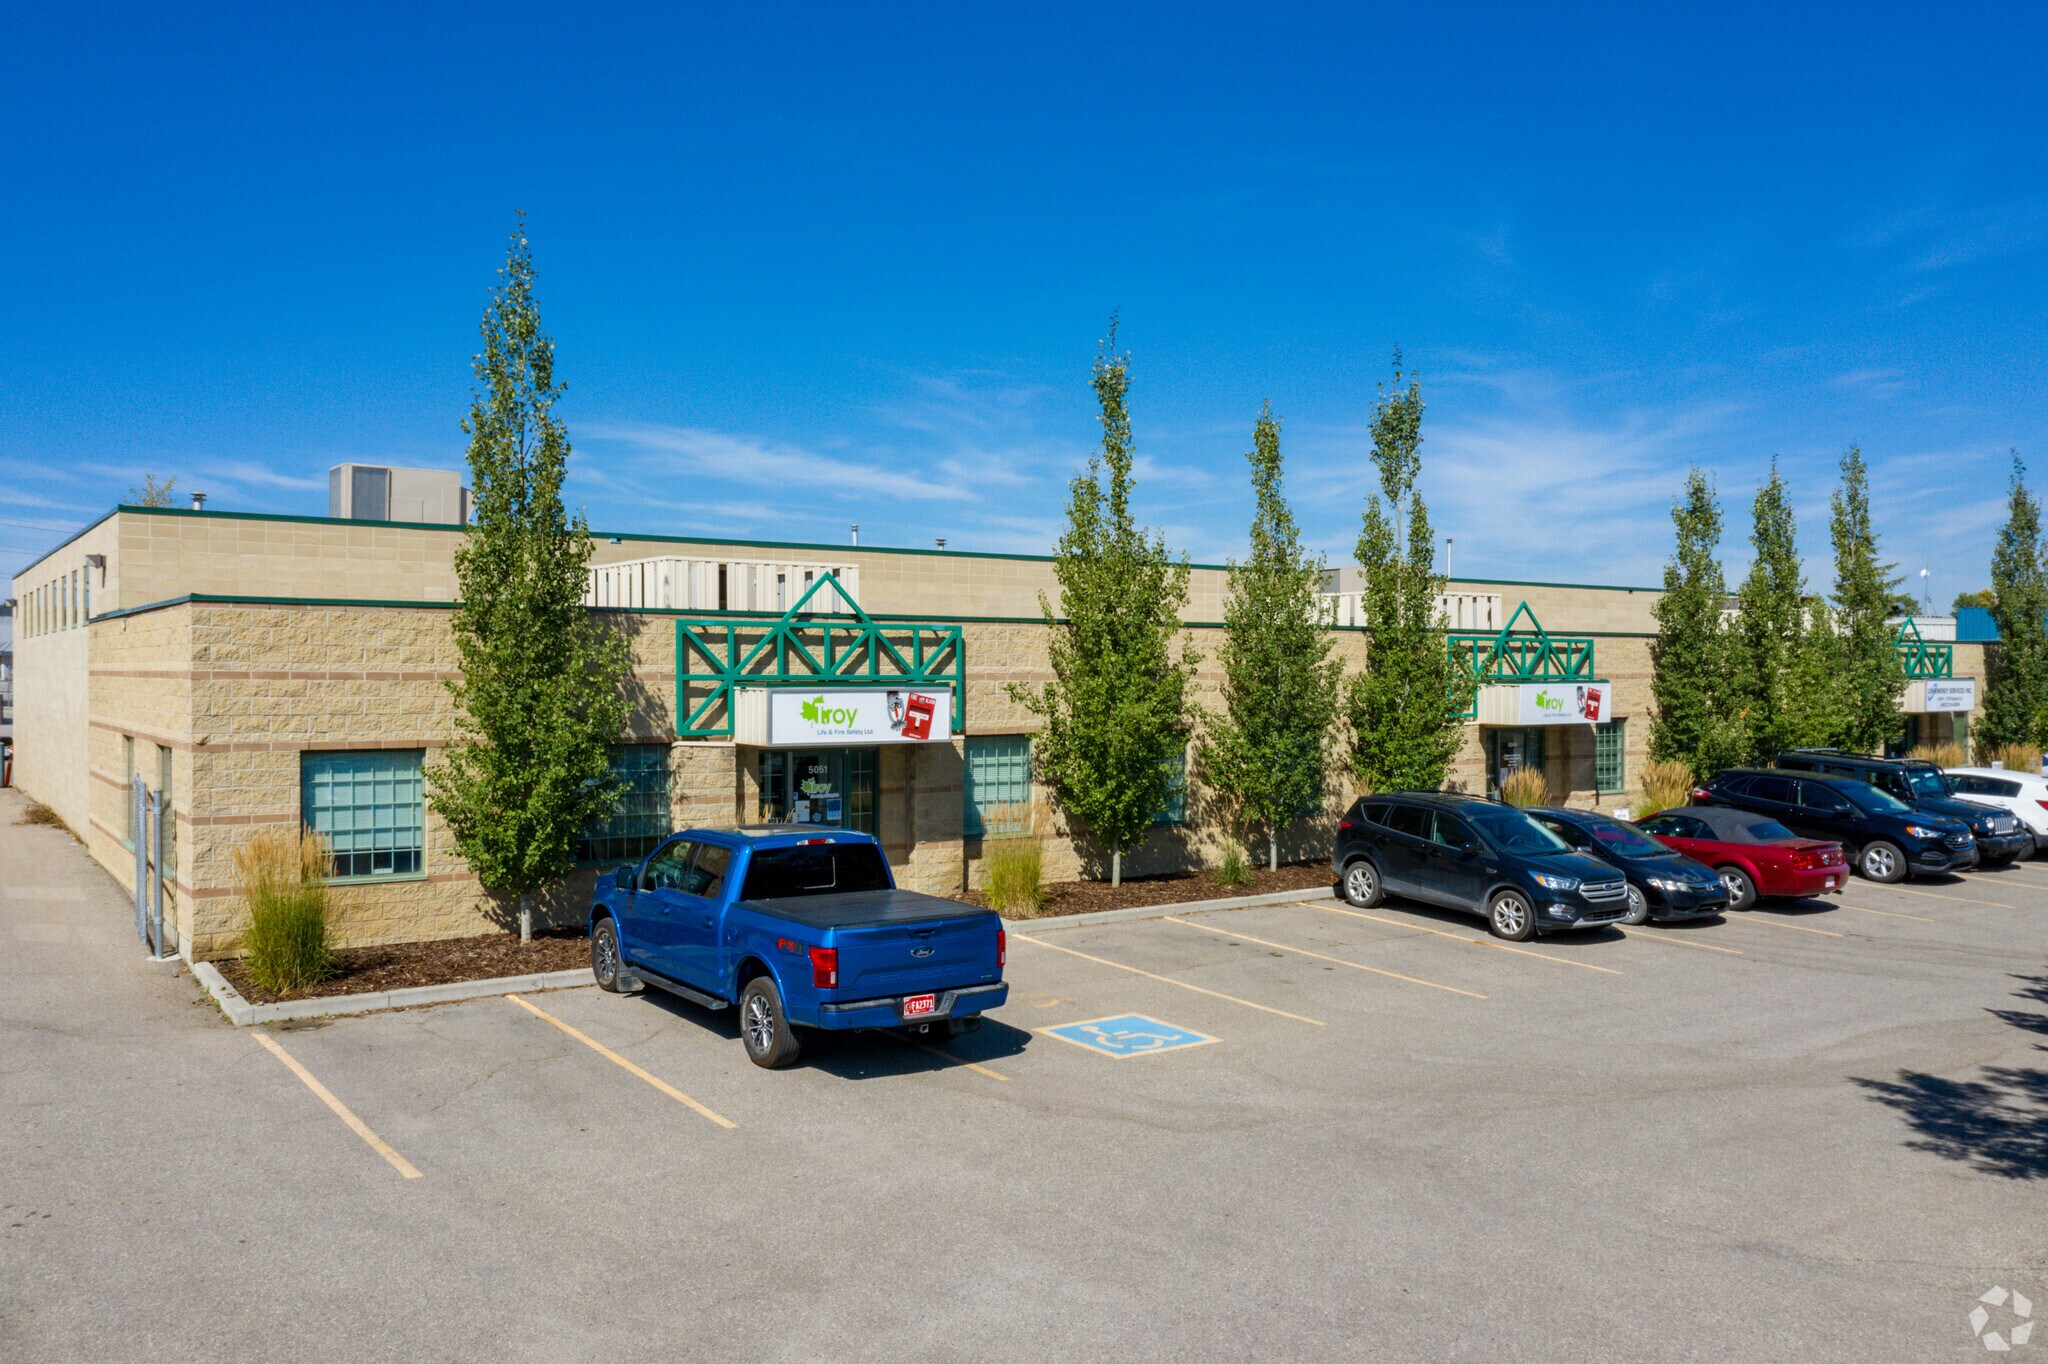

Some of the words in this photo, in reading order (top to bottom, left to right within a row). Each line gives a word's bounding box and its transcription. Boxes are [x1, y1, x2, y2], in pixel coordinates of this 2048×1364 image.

[805, 697, 858, 728] Troy
[846, 729, 863, 737] Safety
[808, 765, 828, 774] 5051
